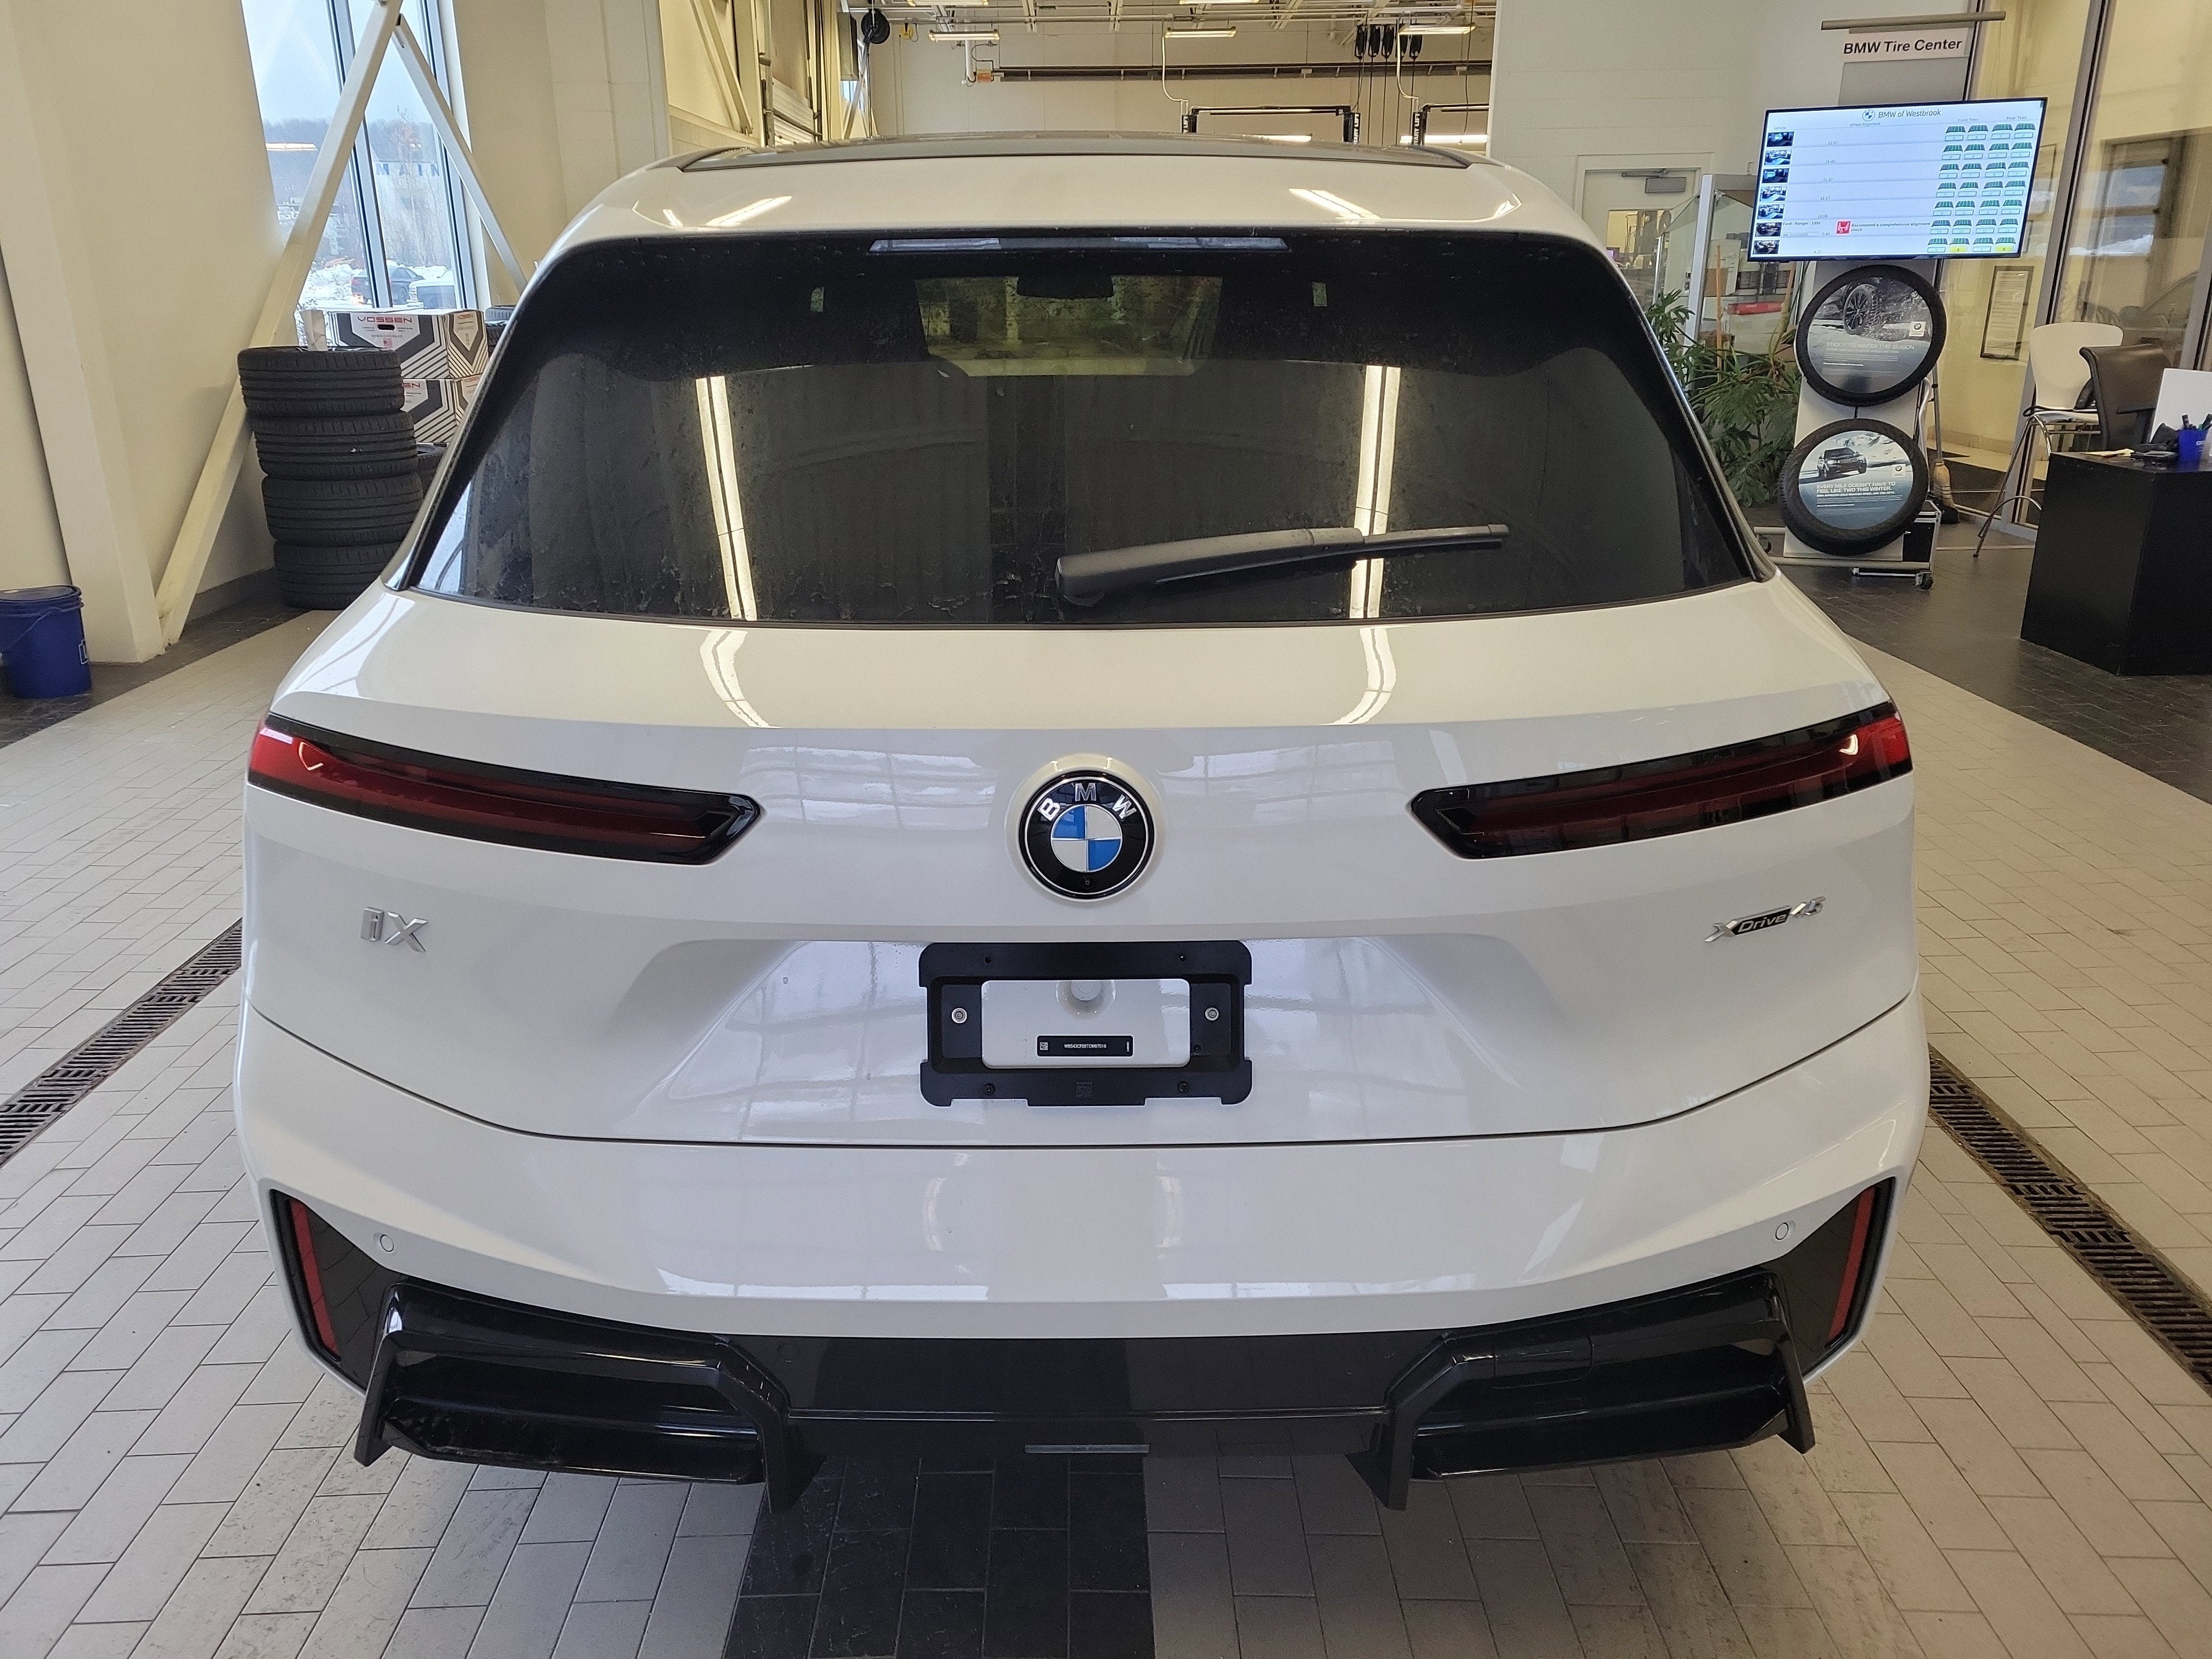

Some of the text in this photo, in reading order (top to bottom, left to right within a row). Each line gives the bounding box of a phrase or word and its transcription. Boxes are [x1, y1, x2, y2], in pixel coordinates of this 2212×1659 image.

[1843, 39, 1962, 54] BMW Tire Center
[1037, 782, 1137, 822] BMW
[360, 907, 428, 952] iX
